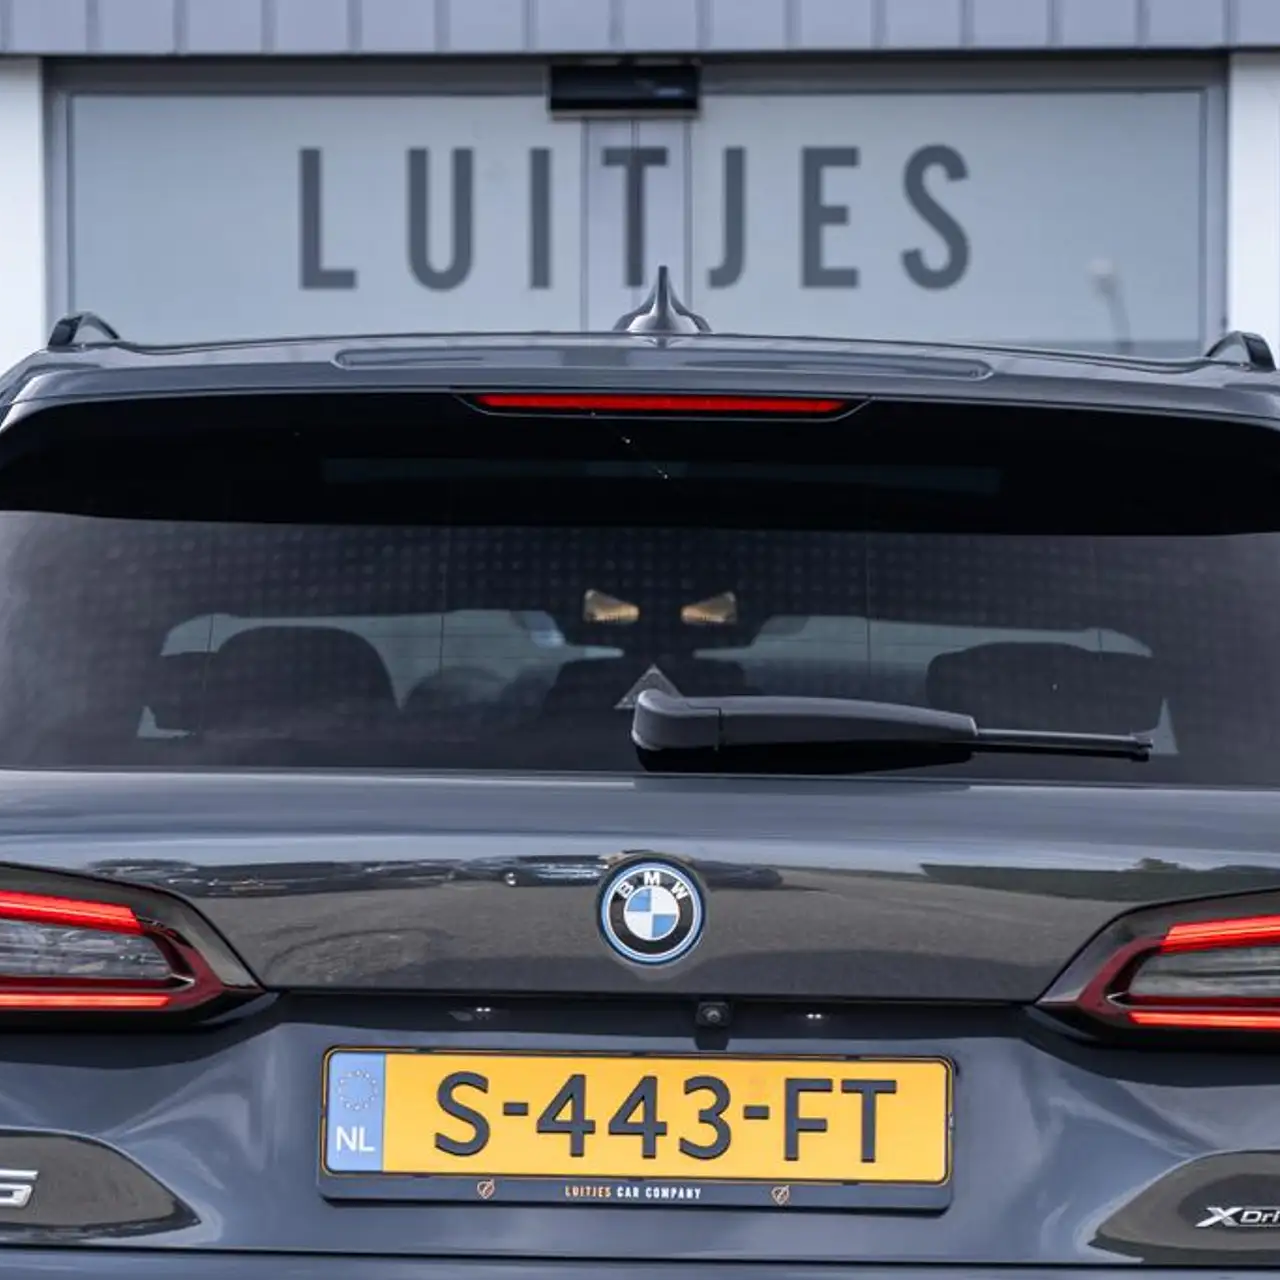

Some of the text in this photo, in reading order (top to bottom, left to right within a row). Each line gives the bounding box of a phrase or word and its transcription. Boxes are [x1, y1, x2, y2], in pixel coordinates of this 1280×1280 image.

[299, 143, 972, 290] LUITJES
[616, 870, 689, 900] BMW
[433, 1071, 897, 1164] S-443-FT
[336, 1125, 376, 1152] NL
[564, 1185, 701, 1200] LUITJES CAR COMPANY
